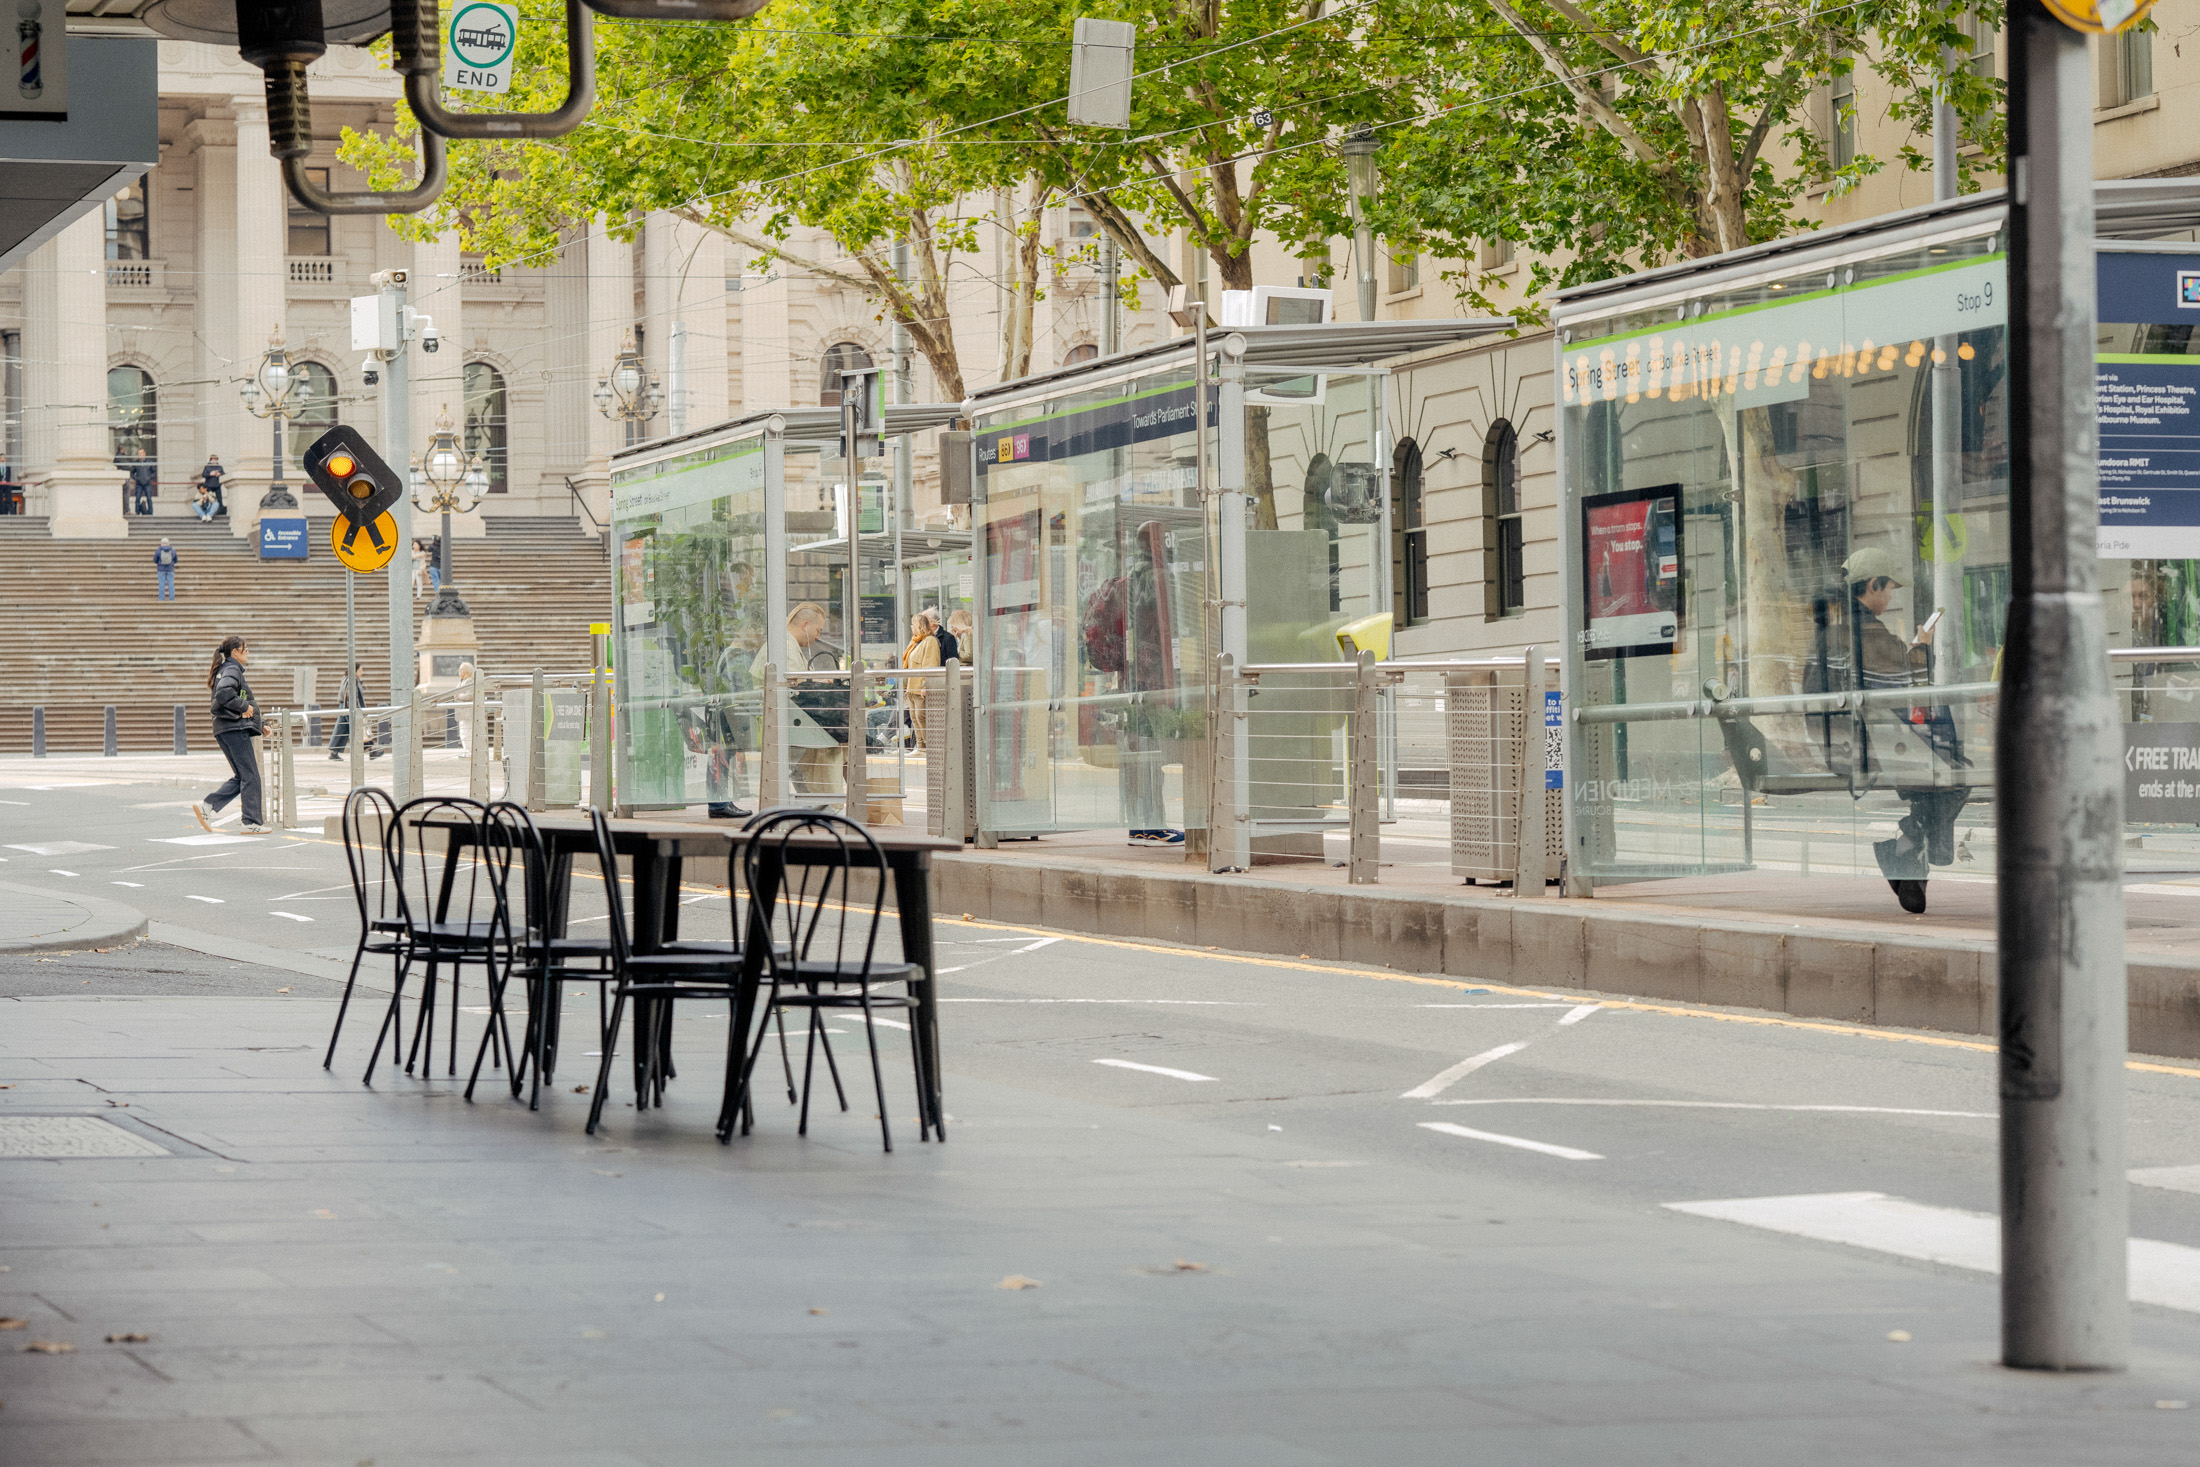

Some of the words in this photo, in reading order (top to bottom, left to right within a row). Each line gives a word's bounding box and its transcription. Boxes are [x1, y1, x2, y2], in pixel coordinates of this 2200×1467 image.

[457, 69, 498, 87] END
[1255, 112, 1272, 126] 63
[1957, 293, 1981, 314] Stop
[1984, 281, 1993, 307] 9
[1568, 365, 1602, 392] Spring
[1605, 355, 1640, 382] Street
[1646, 359, 1659, 374] on
[1660, 353, 1689, 371] Bourke
[1691, 346, 1719, 365] Street
[2108, 384, 2136, 394] Station,
[2136, 385, 2166, 394] Princess
[2166, 385, 2197, 396] Theatre,
[2113, 394, 2127, 405] Eye
[2127, 395, 2141, 403] and
[2141, 395, 2154, 404] Ear
[2154, 396, 2186, 405] Hospital,
[1132, 410, 1156, 430] Towards
[1157, 402, 1190, 425] Parliament
[2103, 405, 2135, 415] Hospital,
[2135, 405, 2154, 415] Royal
[2155, 406, 2190, 414] Exhibition
[2129, 416, 2161, 424] Museum.
[978, 446, 996, 463] Routes
[1000, 439, 1009, 457] 86
[1015, 437, 1024, 455] 96
[2129, 458, 2150, 467] RMIT
[2111, 496, 2151, 506] Brunswick
[1590, 525, 1606, 536] When
[1611, 524, 1625, 533] tram
[1626, 521, 1643, 532] stops.
[1610, 540, 1624, 553] You
[1624, 538, 1643, 554] stop.
[2113, 540, 2130, 550] Pde
[1548, 698, 1557, 706] to
[2135, 747, 2169, 770] FREE
[2171, 747, 2200, 770] TRA
[2139, 779, 2164, 798] ends
[2164, 780, 2176, 798] at
[2177, 779, 2194, 798] the
